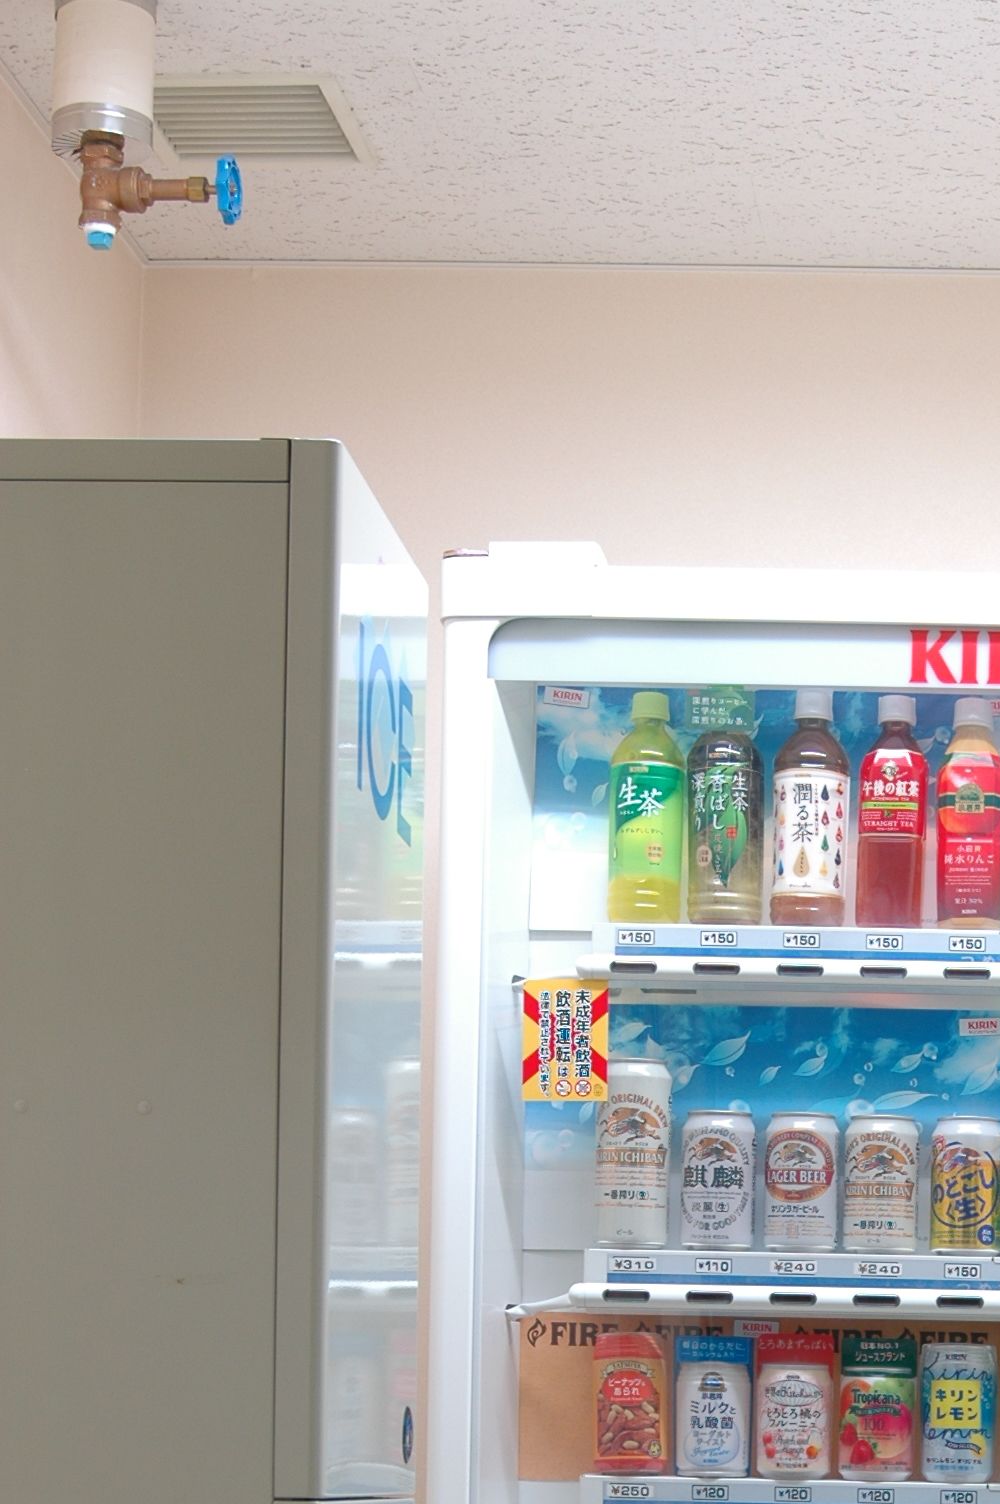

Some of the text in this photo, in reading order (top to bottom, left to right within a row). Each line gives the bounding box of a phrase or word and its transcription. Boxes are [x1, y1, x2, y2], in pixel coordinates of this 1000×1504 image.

[553, 689, 582, 702] KIRIN
[732, 772, 749, 812] 生茶
[863, 779, 920, 798] 午後の紅茶
[617, 776, 665, 818] 生茶
[792, 783, 814, 843] 潤る茶
[863, 820, 899, 828] STRAIGHT
[621, 932, 652, 943] ¥150
[703, 933, 735, 944] ¥150
[785, 935, 817, 947] ¥150
[868, 937, 900, 949] ¥150
[951, 939, 983, 950] ¥150
[968, 1020, 998, 1031] KIRIN
[555, 990, 571, 1077] 飲酒運転は
[574, 989, 591, 1078] 未成年者飲酒
[860, 1132, 901, 1147] ORIGINAL
[620, 1150, 664, 1163] ICHIBAN
[683, 1164, 744, 1190] 麒麟
[767, 1170, 827, 1184] LAGER BEER
[868, 1185, 912, 1197] ICHIBAN
[933, 1169, 996, 1205] のどごし
[613, 1259, 655, 1271] ¥310
[698, 1261, 730, 1272] ¥110
[774, 1261, 816, 1273] ¥240
[858, 1263, 901, 1275] ¥240
[947, 1266, 978, 1278] ¥150
[742, 1322, 773, 1333] KIRIN
[851, 1388, 901, 1406] Tropicana
[935, 1388, 978, 1402] キリン
[690, 1400, 737, 1415] ミルクと
[935, 1406, 978, 1421] レモン
[690, 1416, 734, 1430] 乳酸菌
[611, 1485, 650, 1497] ¥250
[695, 1488, 726, 1499] ¥120
[778, 1489, 808, 1500] ¥120
[861, 1490, 892, 1502] ¥120
[944, 1492, 975, 1504] ¥120
